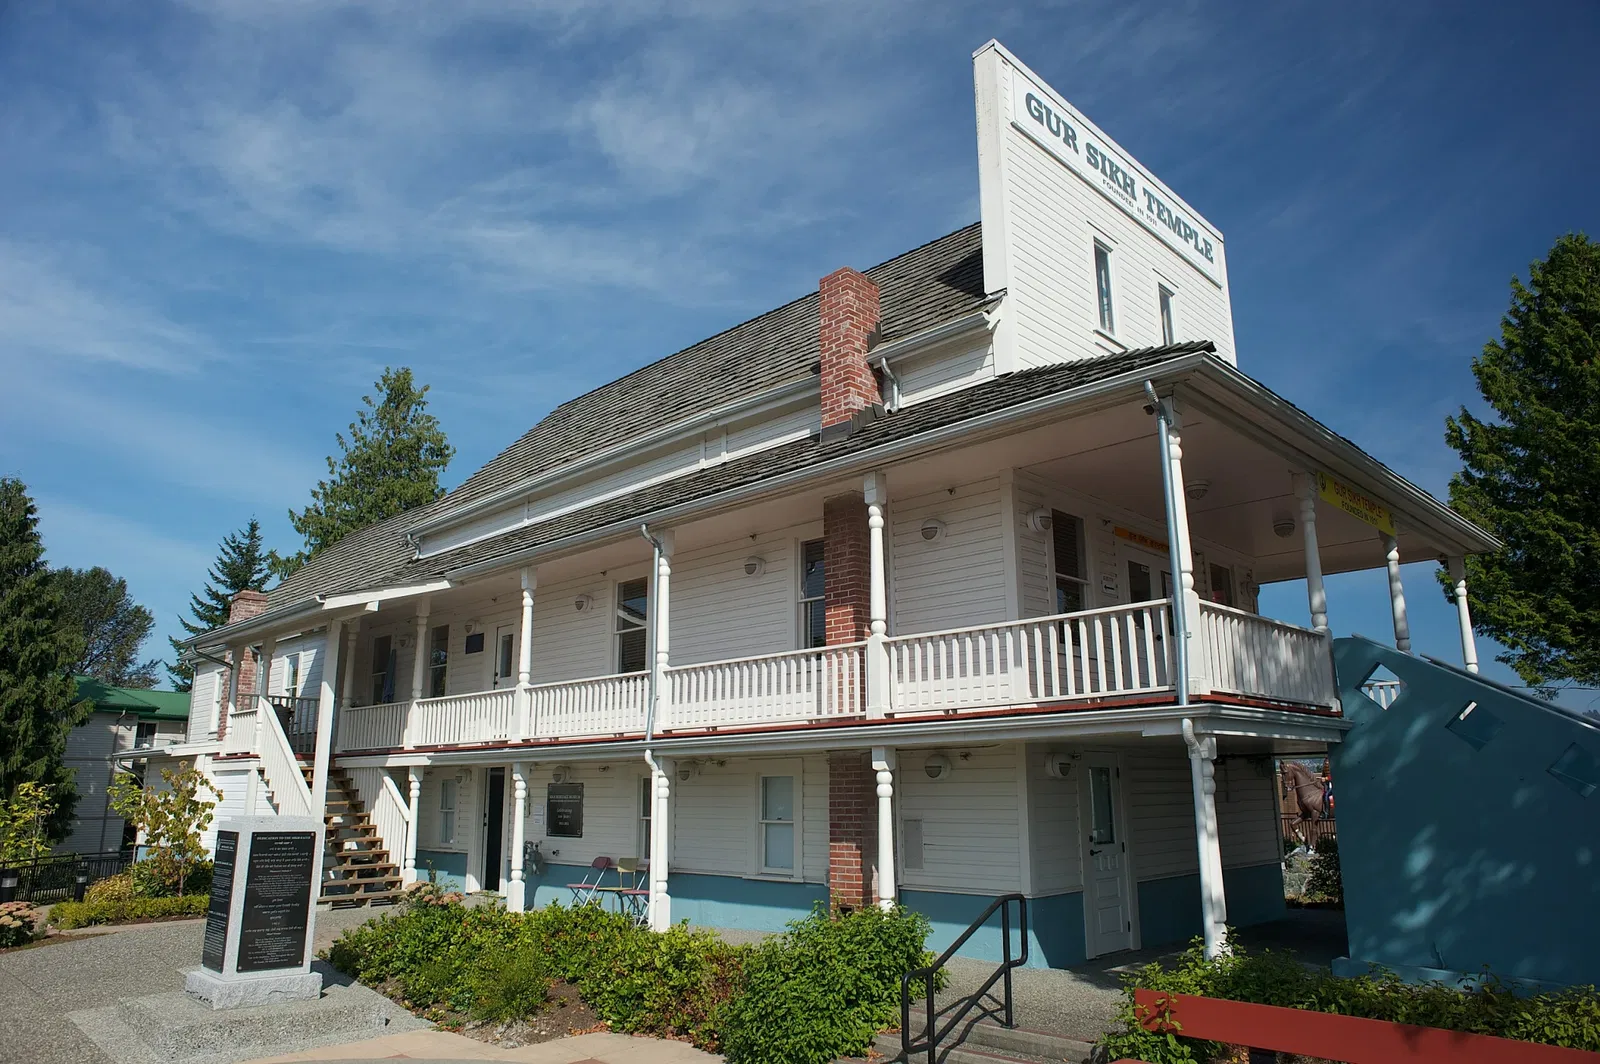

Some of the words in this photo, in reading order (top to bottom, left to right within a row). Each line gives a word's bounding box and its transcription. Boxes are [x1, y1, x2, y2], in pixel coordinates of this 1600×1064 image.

[1025, 92, 1080, 155] GUR
[1085, 142, 1137, 201] SIKH
[1142, 186, 1214, 264] TEMPLE
[1102, 179, 1134, 208] FOUNDED
[1137, 206, 1144, 216] IN
